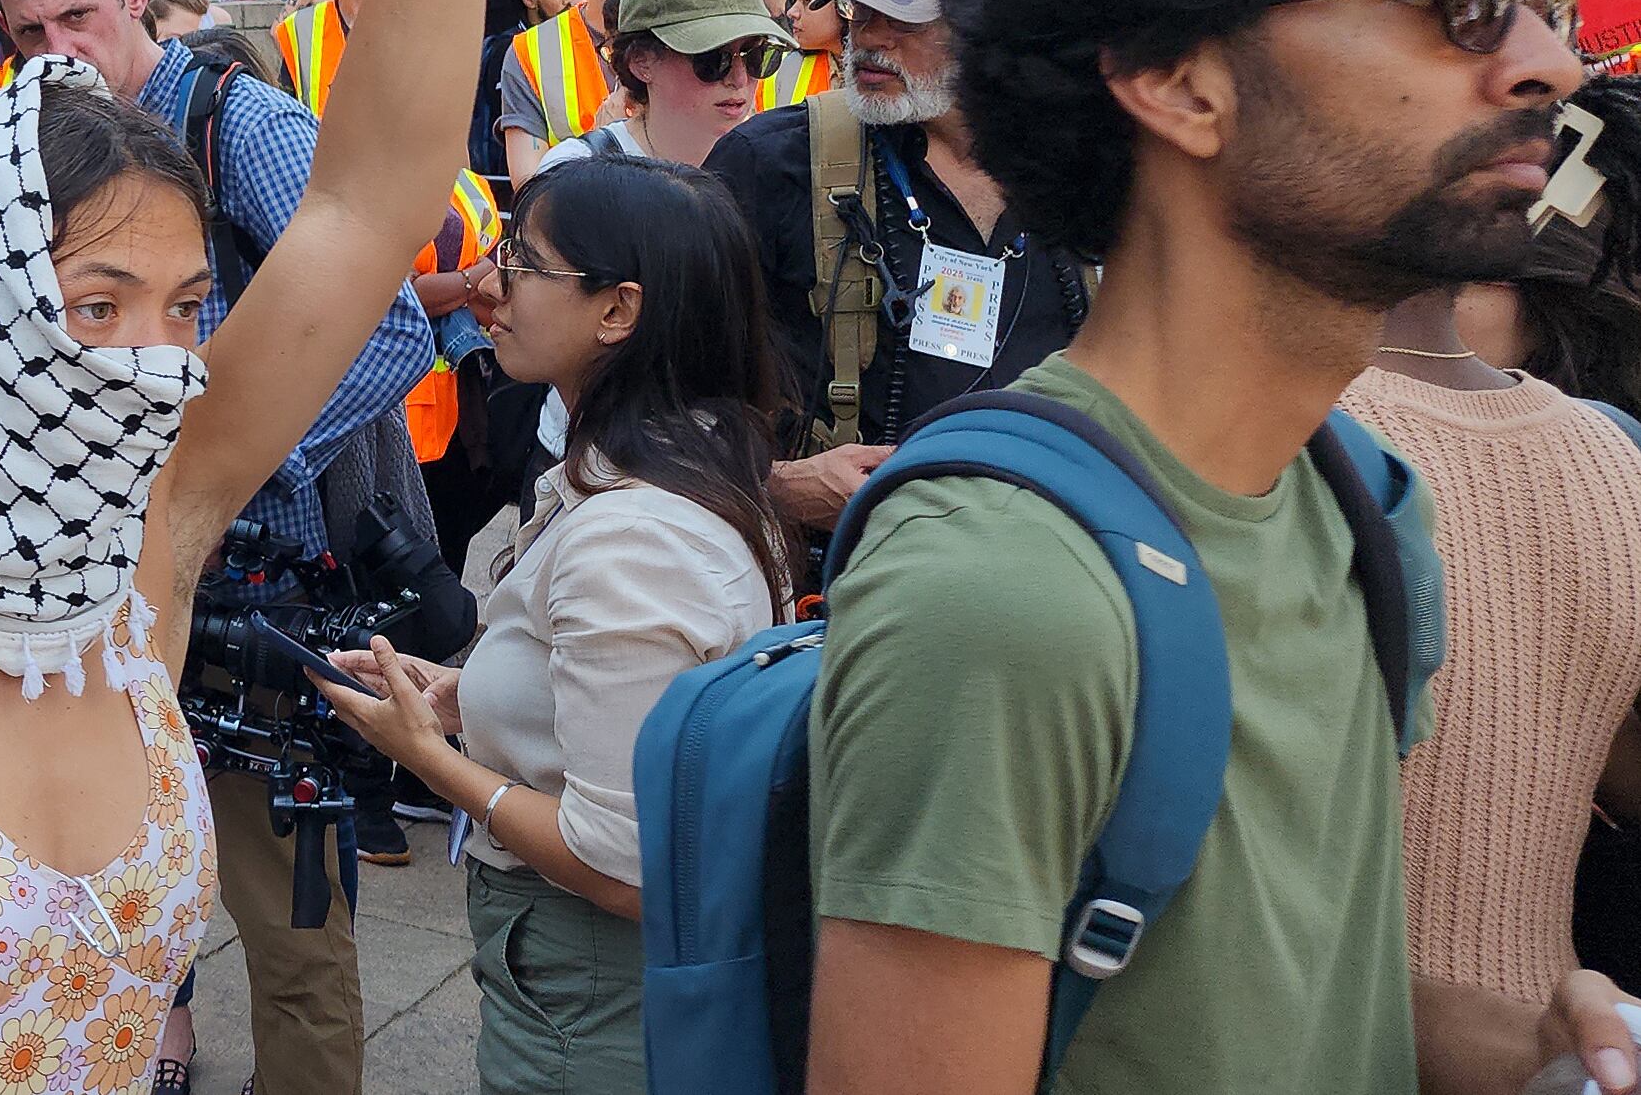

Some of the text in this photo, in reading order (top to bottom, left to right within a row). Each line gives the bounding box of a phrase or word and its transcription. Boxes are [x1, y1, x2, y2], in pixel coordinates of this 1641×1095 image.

[933, 253, 948, 263] City
[959, 259, 973, 268] New
[975, 262, 993, 273] York
[941, 266, 964, 278] 2025
[983, 280, 1000, 343] PRESS
[912, 337, 990, 363] PRESS PRESS
